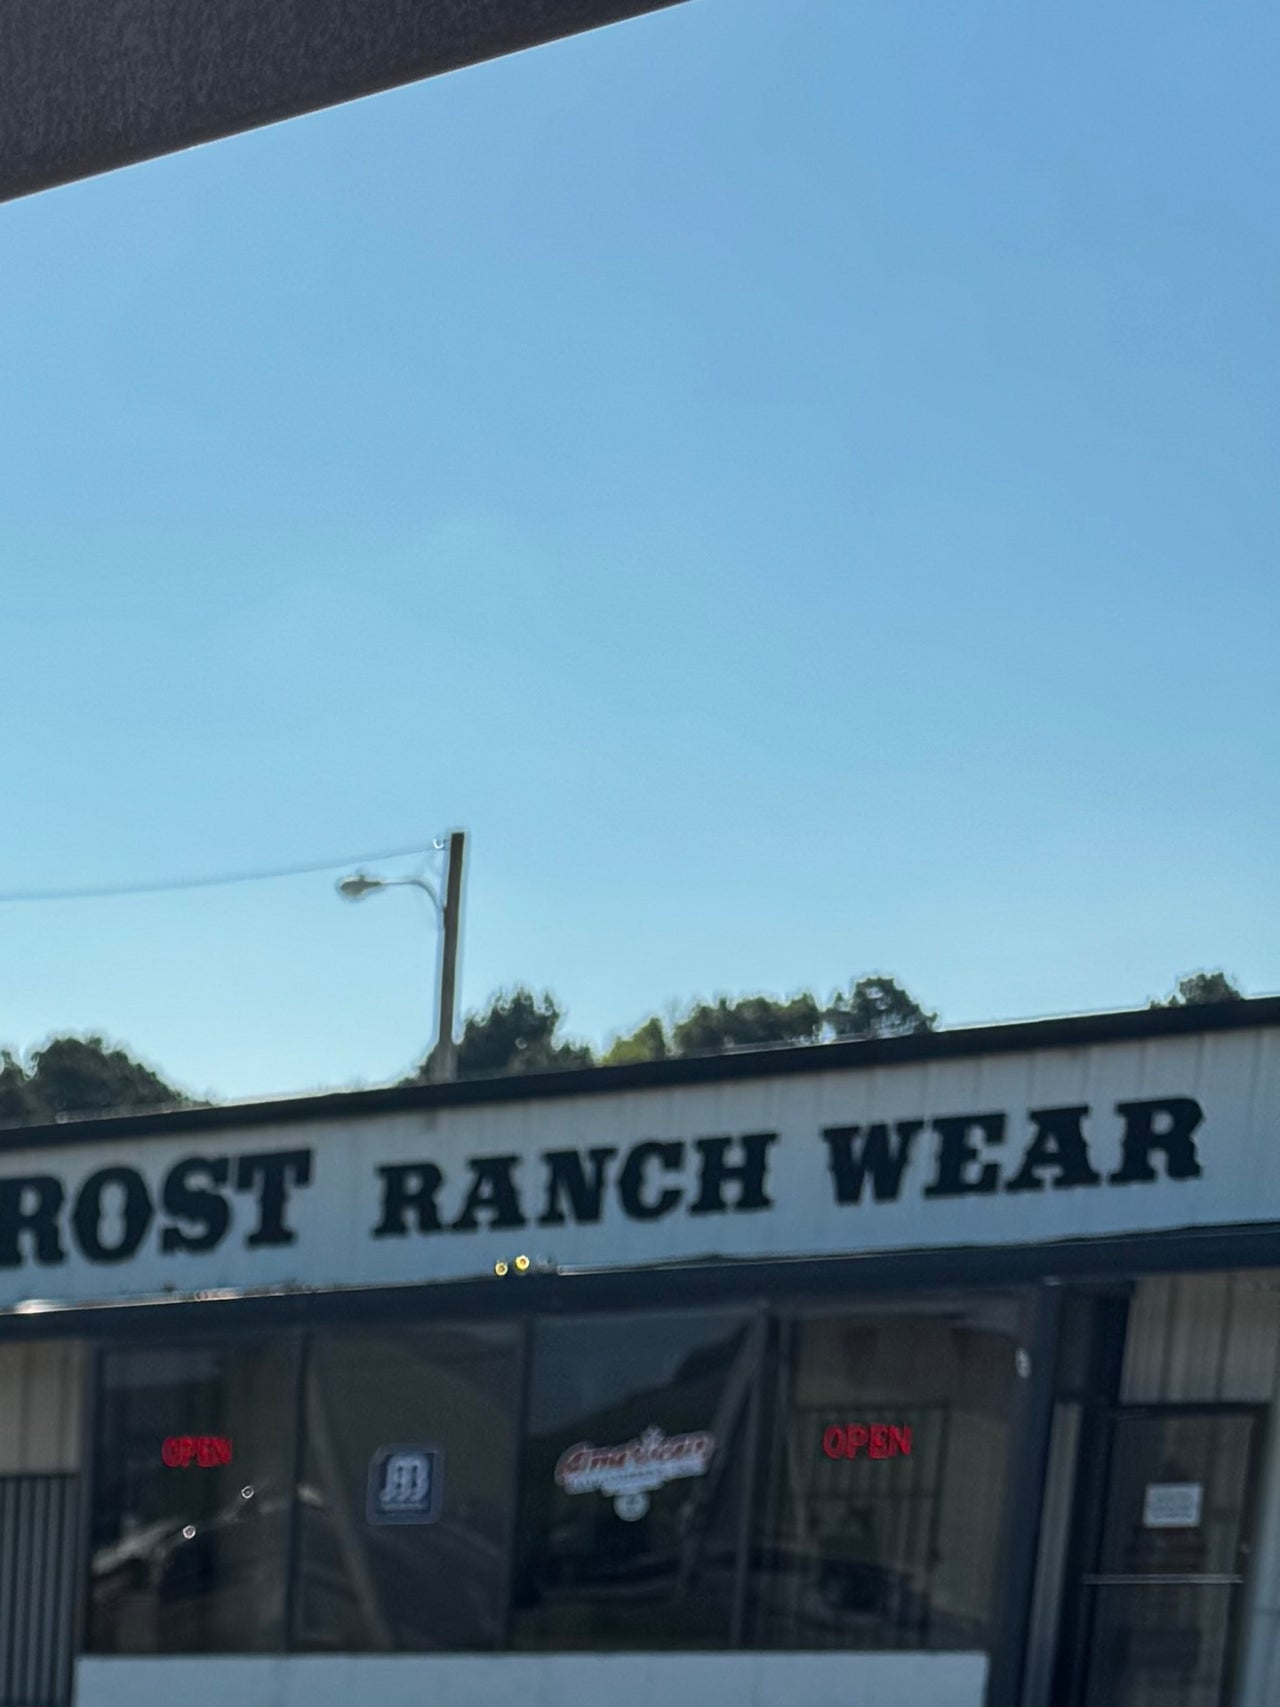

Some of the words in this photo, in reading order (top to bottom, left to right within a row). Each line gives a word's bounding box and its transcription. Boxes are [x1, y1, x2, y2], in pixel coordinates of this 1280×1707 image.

[371, 1132, 781, 1238] RANCH
[823, 1096, 1206, 1205] WEAR
[161, 1435, 233, 1469] OPEN
[823, 1423, 912, 1460] OPEN
